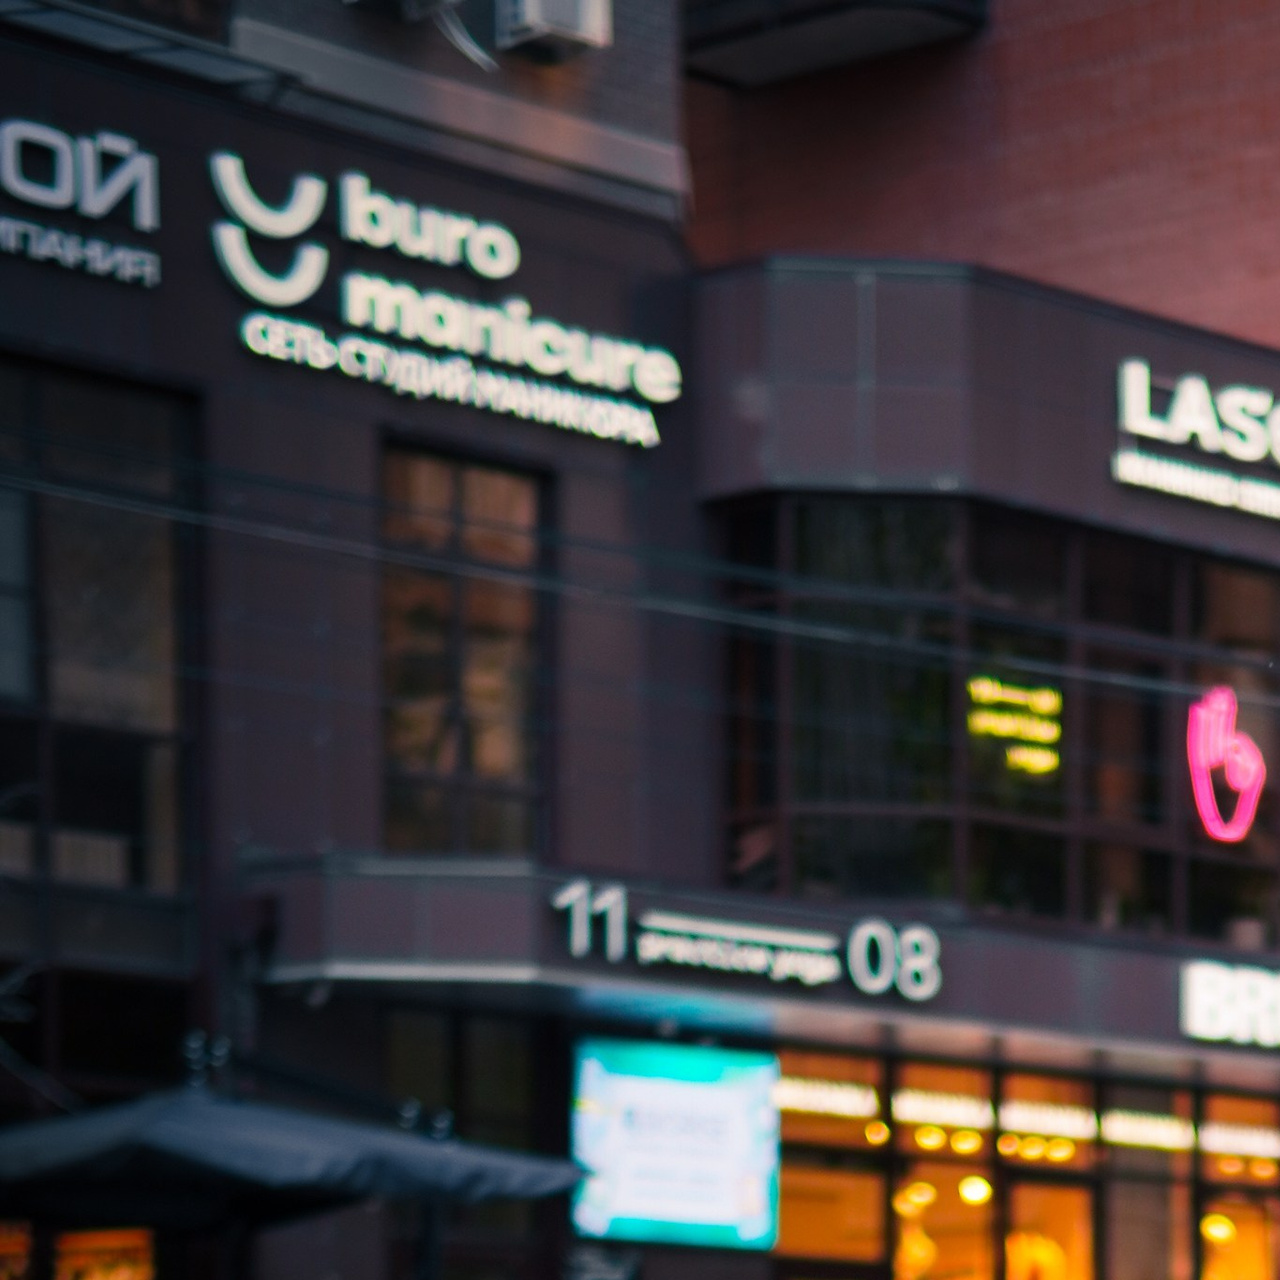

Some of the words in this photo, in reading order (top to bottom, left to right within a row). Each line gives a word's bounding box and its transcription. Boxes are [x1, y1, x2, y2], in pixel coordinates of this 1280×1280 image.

[340, 172, 521, 280] buro
[241, 311, 337, 371] СЕТЬ
[342, 272, 684, 405] manicure
[553, 880, 628, 963] 11
[847, 916, 943, 1001] 08
